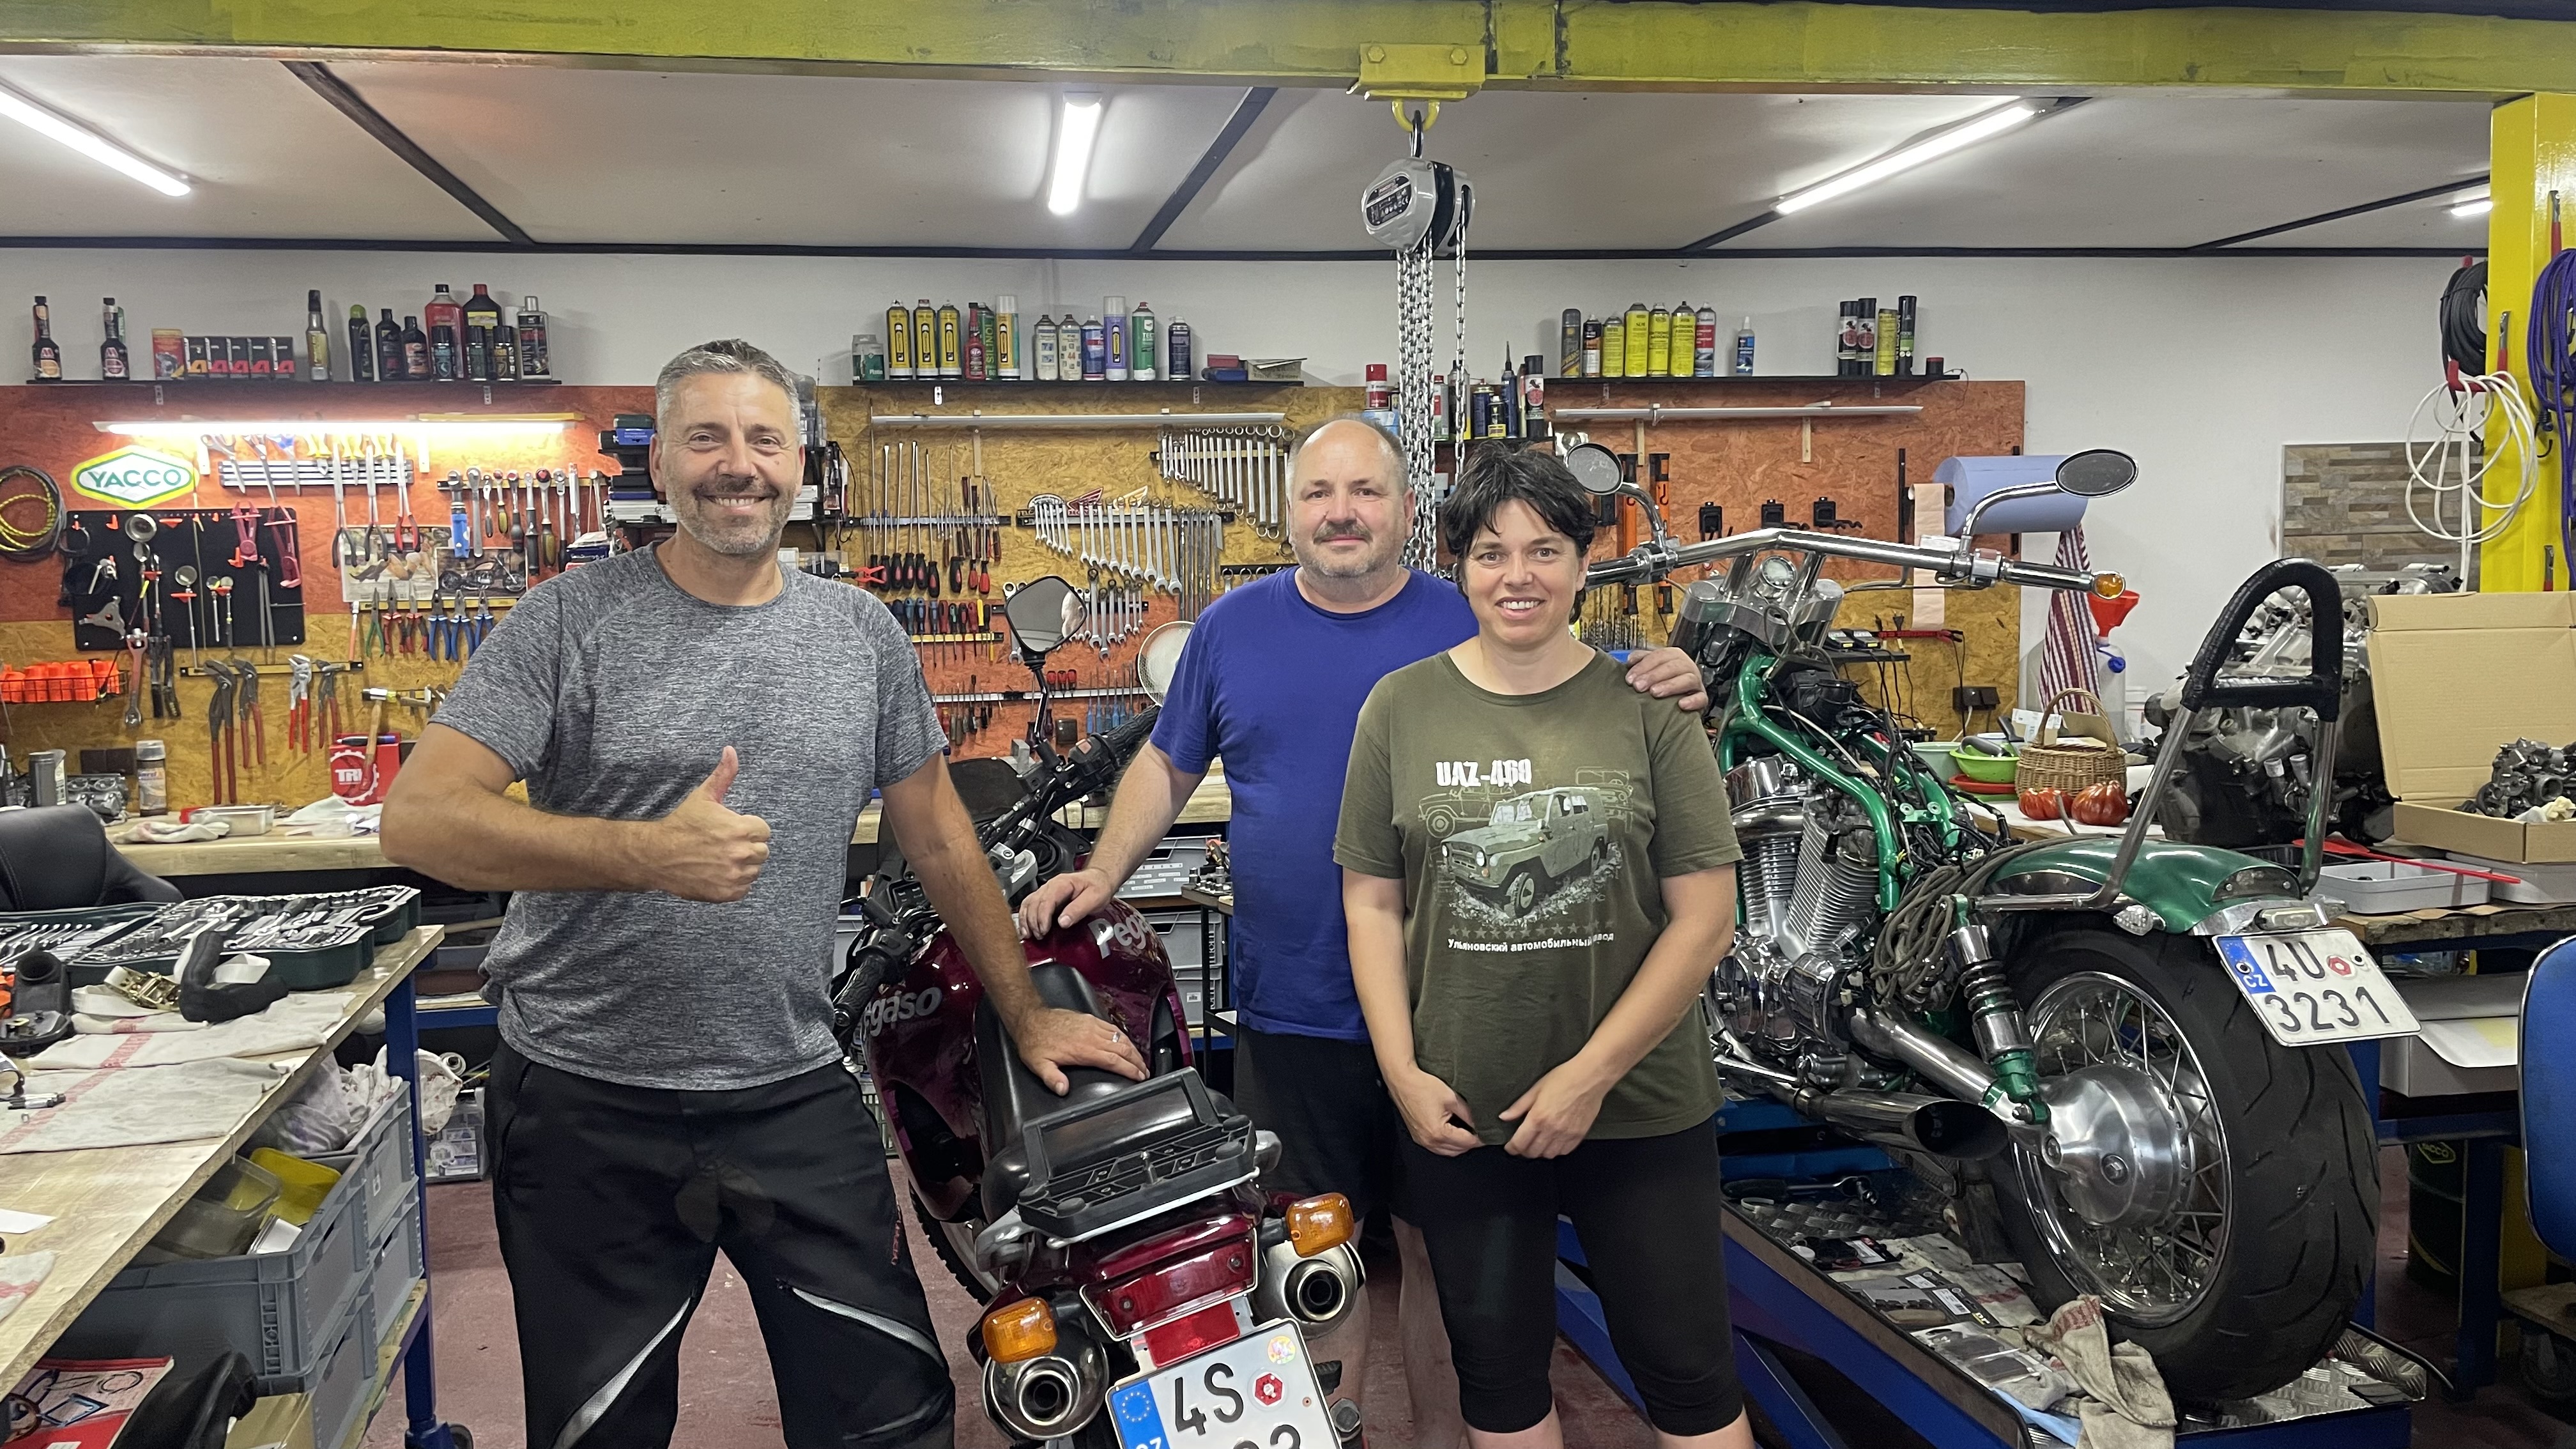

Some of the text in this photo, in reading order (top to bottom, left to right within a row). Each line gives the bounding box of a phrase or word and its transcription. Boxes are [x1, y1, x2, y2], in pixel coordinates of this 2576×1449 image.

[88, 469, 181, 488] YACCO
[1436, 758, 1532, 787] UAZ-469
[1087, 914, 1149, 960] Pega
[1448, 939, 1508, 953] Ульяновский
[1510, 937, 1592, 953] автомобильный
[2266, 942, 2326, 981] 4U
[2243, 974, 2269, 988] CZ
[2264, 986, 2390, 1032] 3231
[1174, 1362, 1244, 1436] 4S
